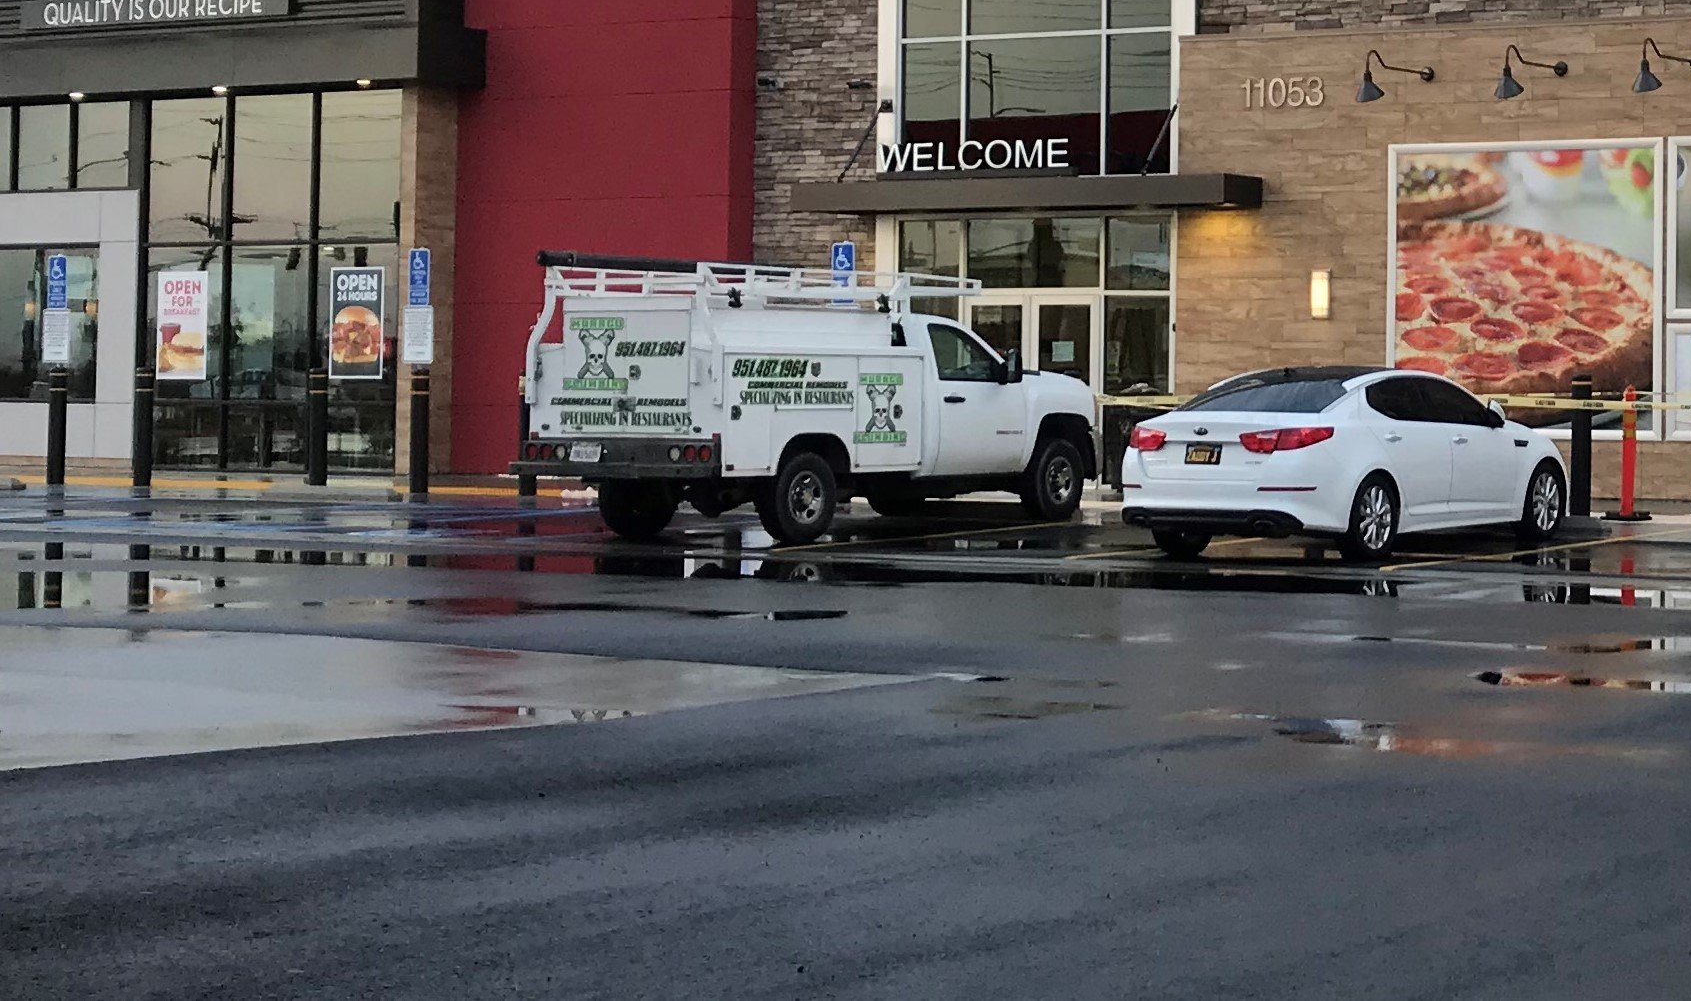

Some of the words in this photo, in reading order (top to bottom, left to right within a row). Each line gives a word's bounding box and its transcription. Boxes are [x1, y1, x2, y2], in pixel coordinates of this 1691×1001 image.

[1241, 76, 1324, 108] 11053
[879, 138, 1069, 172] WELCOME
[164, 280, 201, 294] OPEN
[337, 274, 378, 290] OPEN
[172, 296, 192, 307] FOR
[337, 291, 347, 301] 24
[348, 291, 378, 301] HOURS
[732, 358, 810, 378] 951.487.1964
[747, 381, 803, 389] COMMERCIAL
[805, 381, 848, 389] REMODELS
[550, 397, 612, 406] COMMERCIAL
[636, 398, 687, 407] REMODELS
[794, 390, 803, 405] IN
[805, 390, 855, 405] RESTAURANTS
[619, 412, 629, 426] IN
[631, 411, 692, 427] RESTAURANTS
